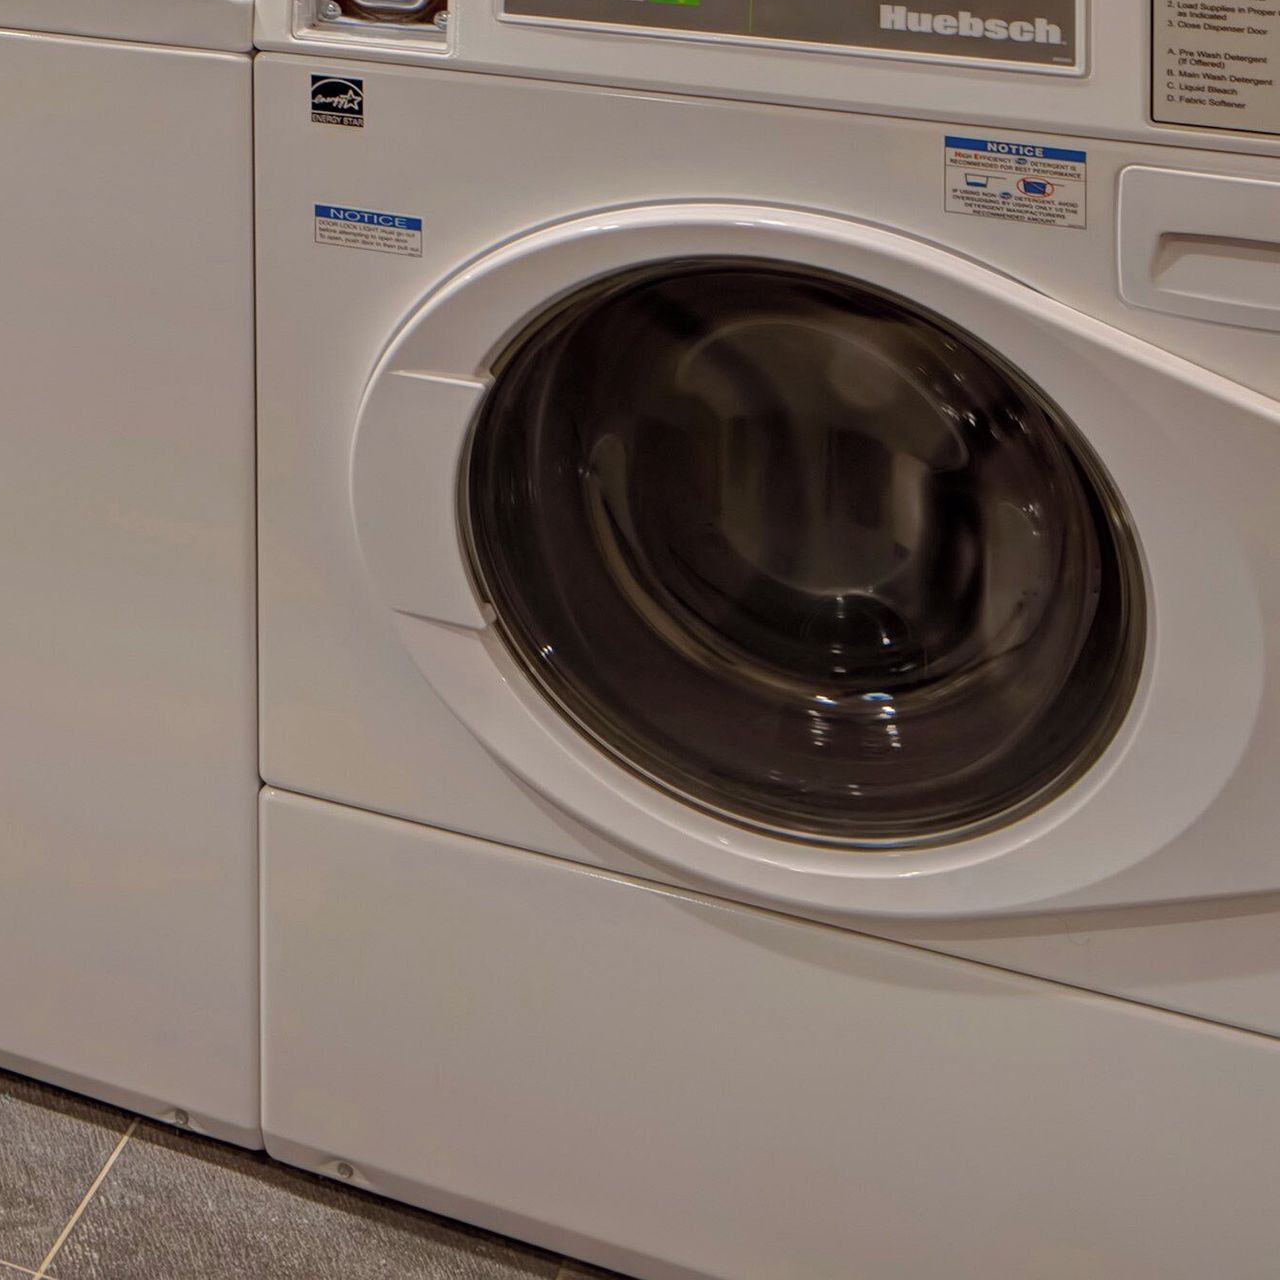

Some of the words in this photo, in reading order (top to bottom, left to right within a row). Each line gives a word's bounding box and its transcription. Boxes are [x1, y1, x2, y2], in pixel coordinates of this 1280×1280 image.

[1177, 1, 1198, 10] Load
[1200, 3, 1235, 14] Supplies
[1248, 8, 1275, 17] Proper
[1190, 12, 1227, 21] Indicated
[880, 4, 1062, 45] Huebsch
[1177, 21, 1201, 30] Close
[1203, 23, 1245, 34] Dispenser
[1248, 27, 1268, 35] Door
[1179, 49, 1194, 57] Pre
[1197, 51, 1221, 59] Wash
[1224, 53, 1267, 64] Detergent
[1190, 59, 1225, 69] Offered)
[1179, 70, 1200, 79] Main
[1202, 72, 1226, 81] Wash
[1229, 75, 1273, 86] Detergent
[1179, 83, 1205, 93] Liquid
[1208, 86, 1238, 95] Bleach
[1179, 95, 1206, 105] Fabric
[1209, 99, 1246, 109] Softener
[312, 114, 341, 124] ENERGY
[343, 117, 364, 127] STAR
[987, 142, 1044, 157] NOTICE
[950, 159, 999, 169] RECOMMENDED
[1033, 168, 1081, 179] PERFORMANCE
[974, 153, 1012, 164] EFFICIENCY
[1030, 161, 1069, 171] DETERGENT
[330, 209, 407, 228] NOTICE
